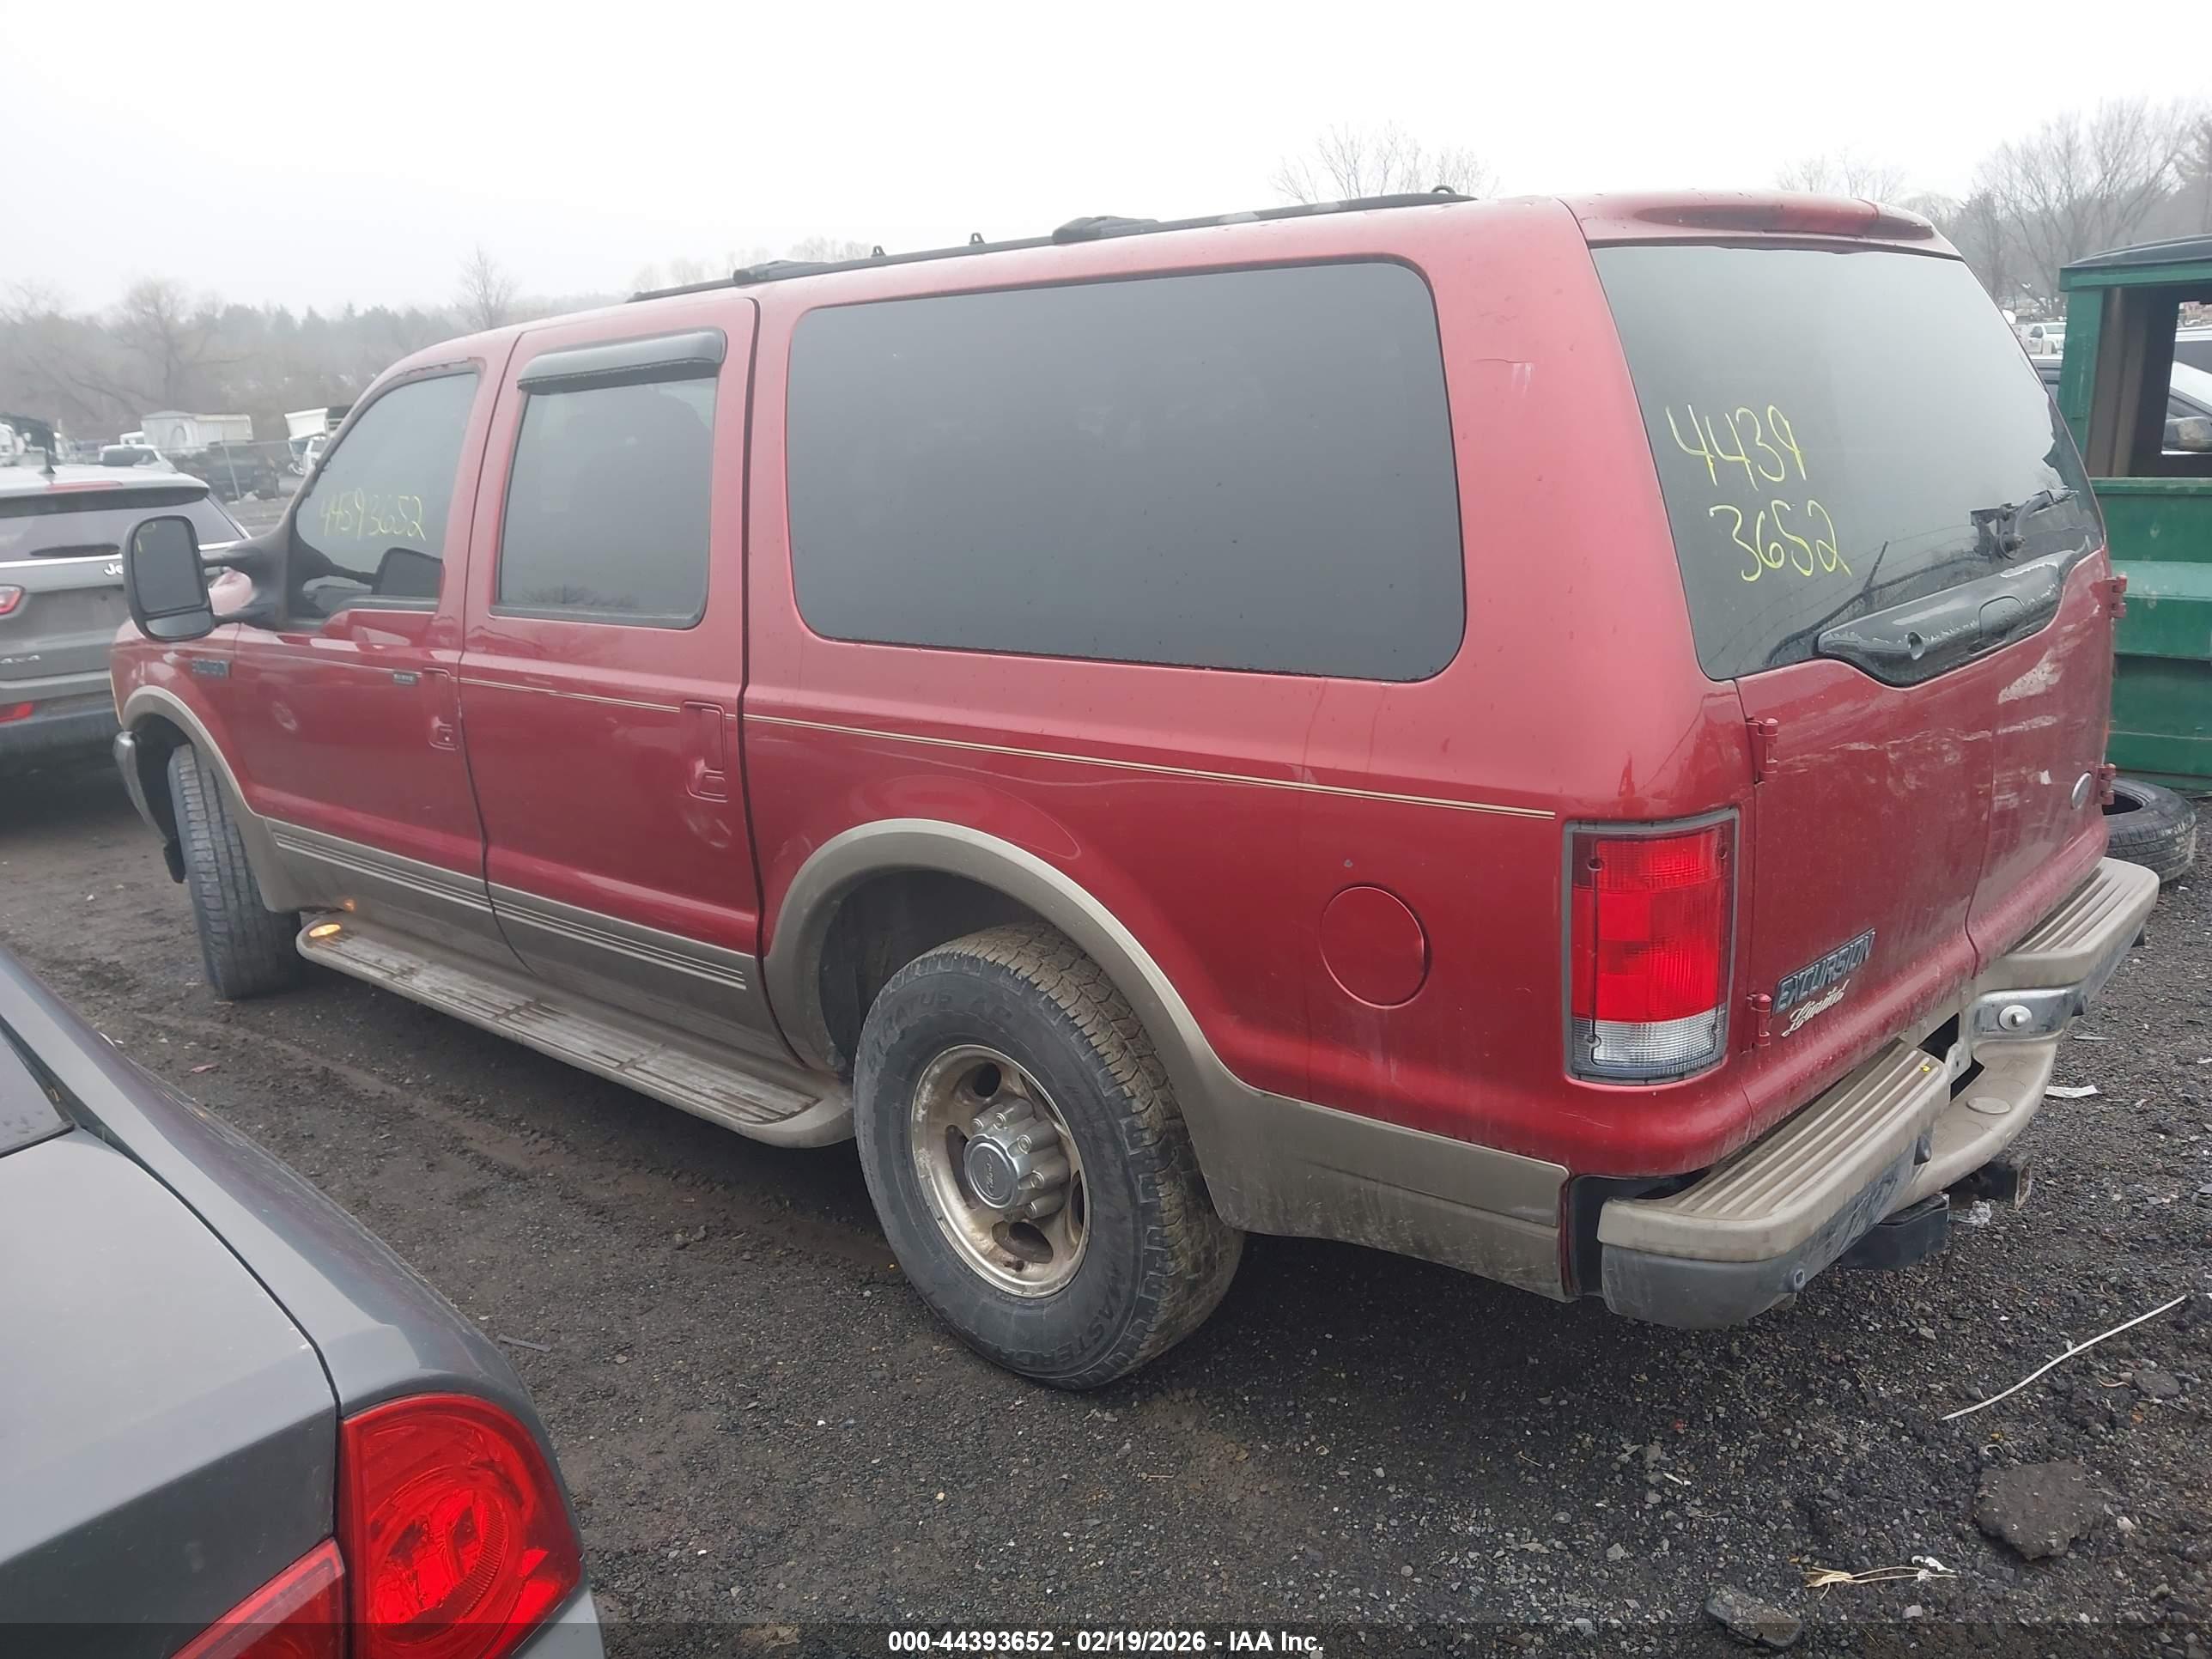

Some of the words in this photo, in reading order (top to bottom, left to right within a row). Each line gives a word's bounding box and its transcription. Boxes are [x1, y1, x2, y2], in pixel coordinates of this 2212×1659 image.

[1665, 404, 1807, 492] 4439
[103, 562, 125, 576] Je
[1709, 499, 1853, 582] 3652
[1775, 929, 1876, 1015] EXCURSION
[1781, 978, 1850, 1038] Limited
